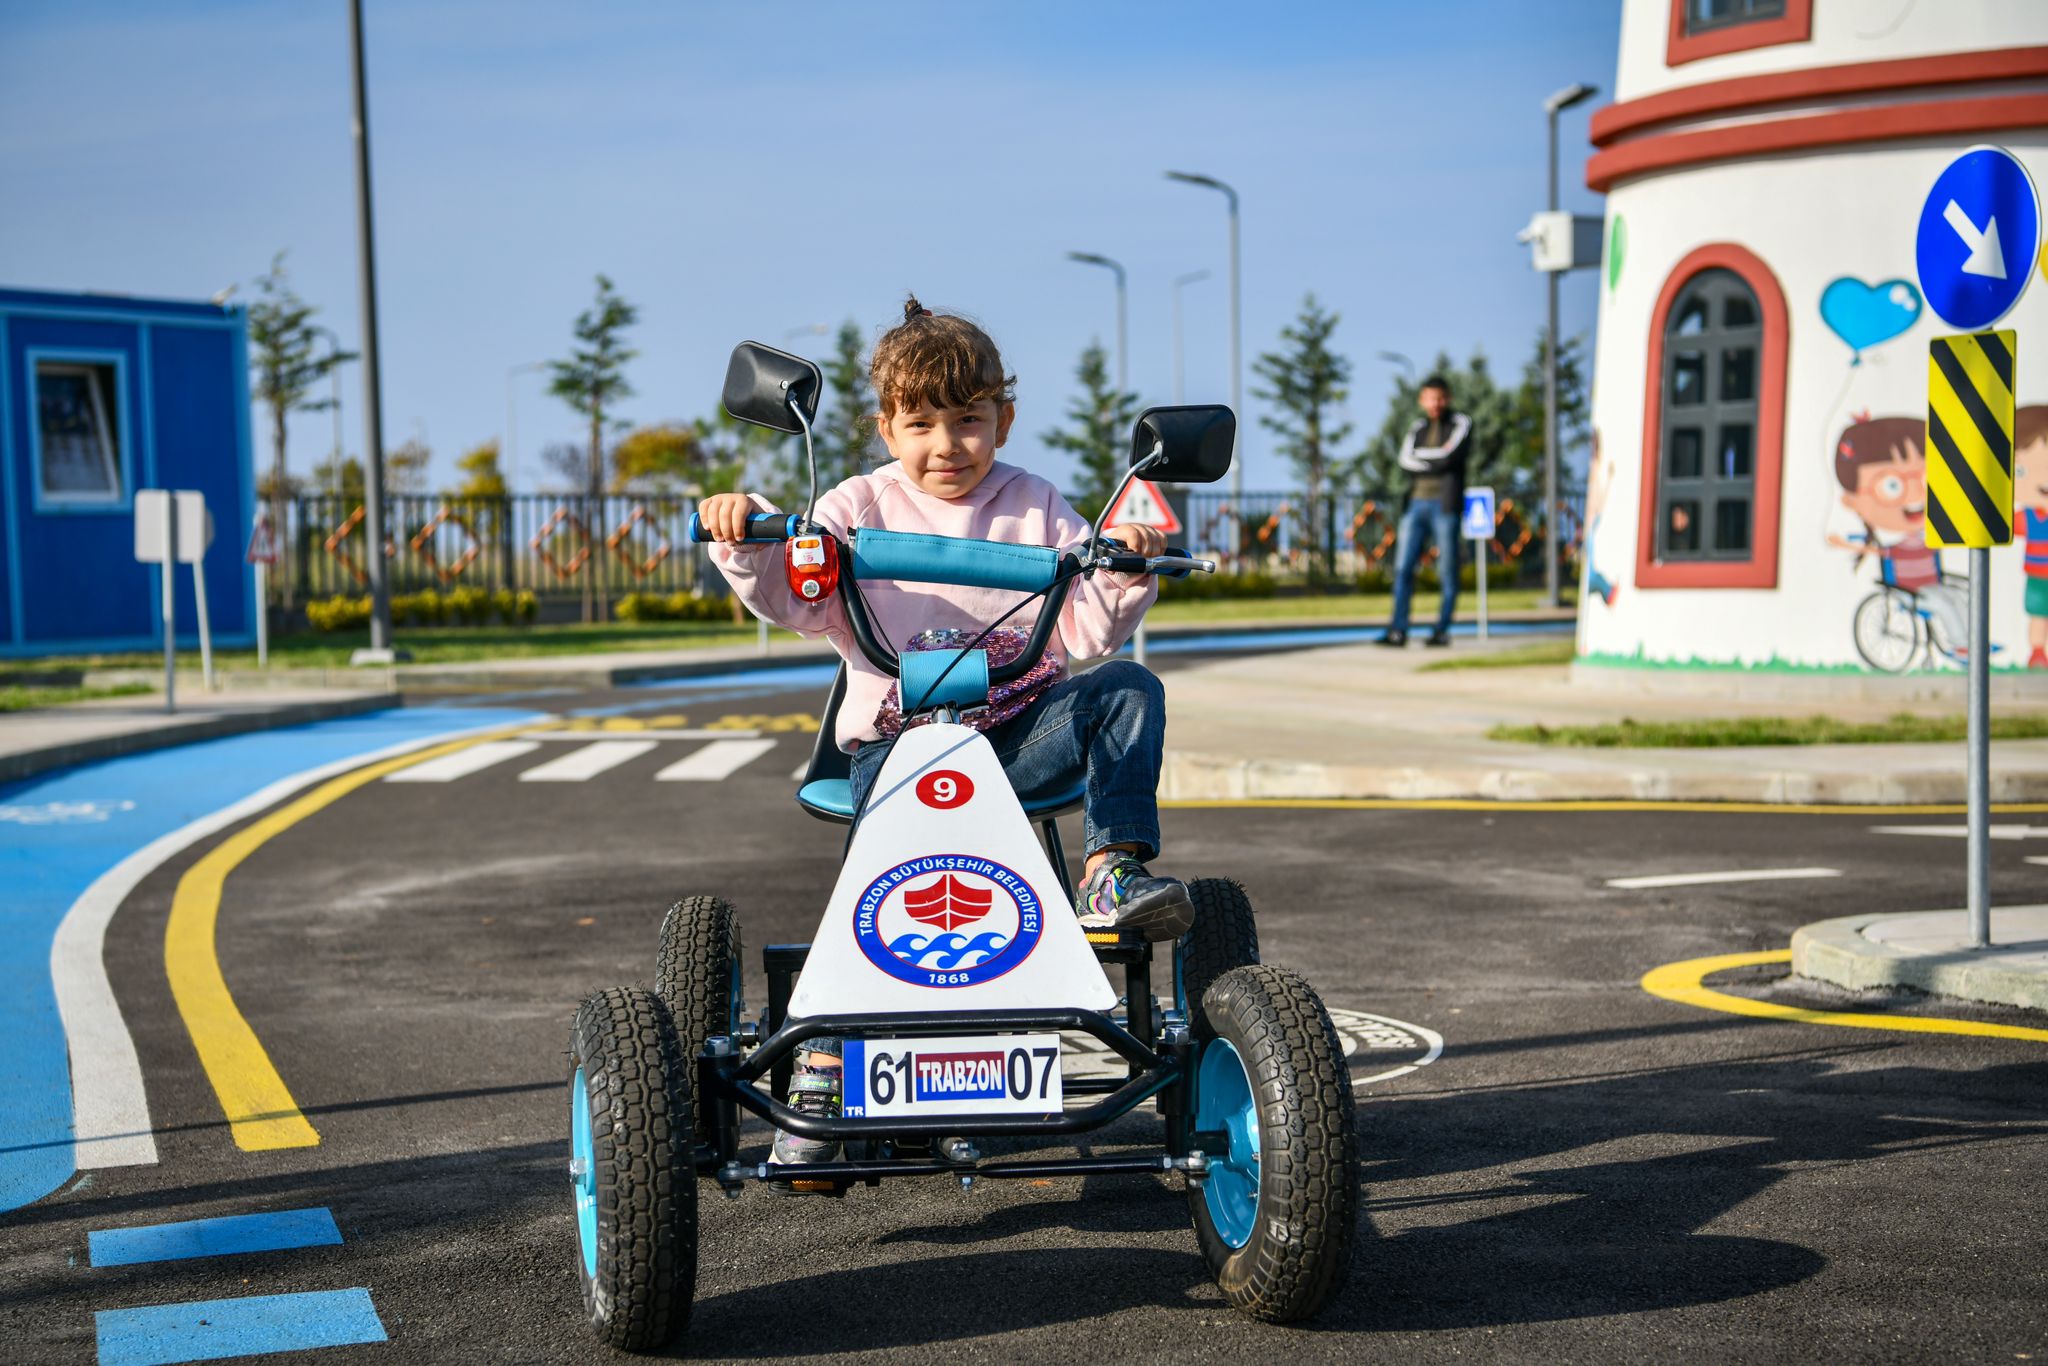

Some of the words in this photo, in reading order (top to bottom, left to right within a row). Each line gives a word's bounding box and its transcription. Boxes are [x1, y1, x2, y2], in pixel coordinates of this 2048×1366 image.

[933, 777, 957, 802] 9
[859, 880, 893, 936] TRABZON
[889, 858, 994, 882] BÜYÜKŞEHİR
[993, 871, 1039, 933] BELEDİYESİ
[928, 973, 970, 984] 1868
[869, 1051, 914, 1106] 61
[919, 1059, 1003, 1093] TRABZON
[1007, 1047, 1058, 1101] 07
[845, 1106, 864, 1116] TR
